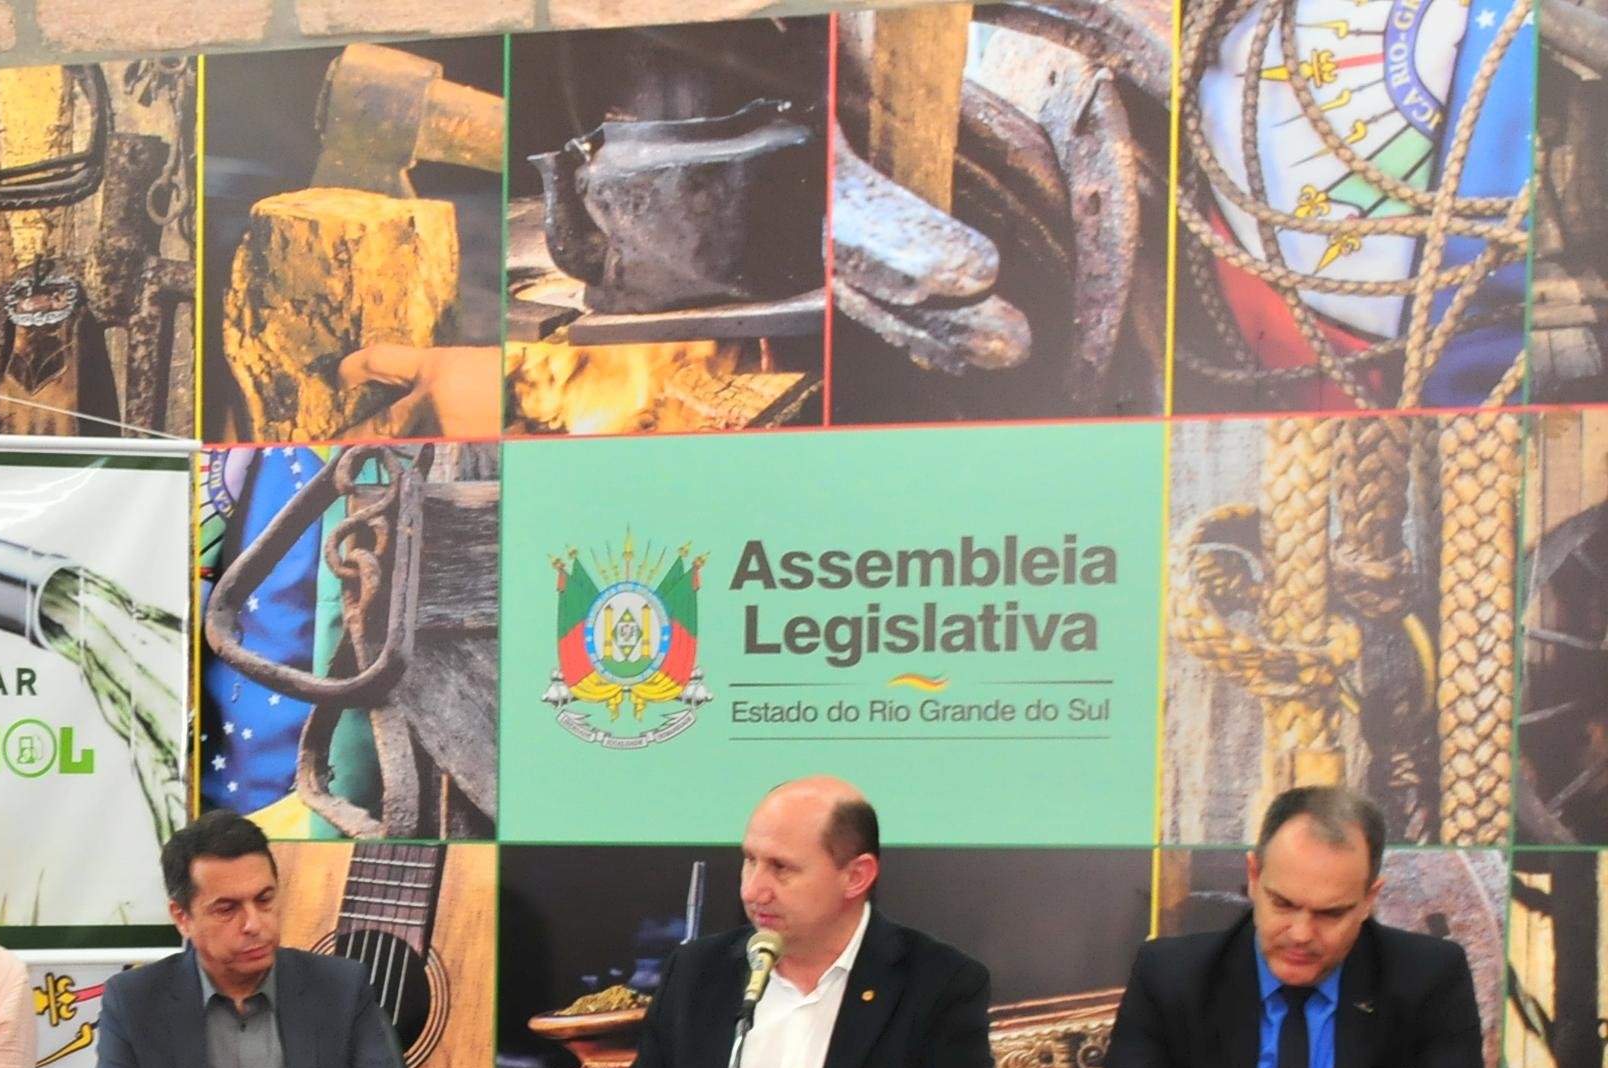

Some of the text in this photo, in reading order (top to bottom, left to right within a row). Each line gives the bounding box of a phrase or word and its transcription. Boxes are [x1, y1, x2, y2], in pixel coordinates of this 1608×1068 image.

[729, 534, 1117, 590] Assembleia
[744, 601, 1098, 668] Legislativa
[732, 698, 1110, 723] Estado do Rio Grande do Sul
